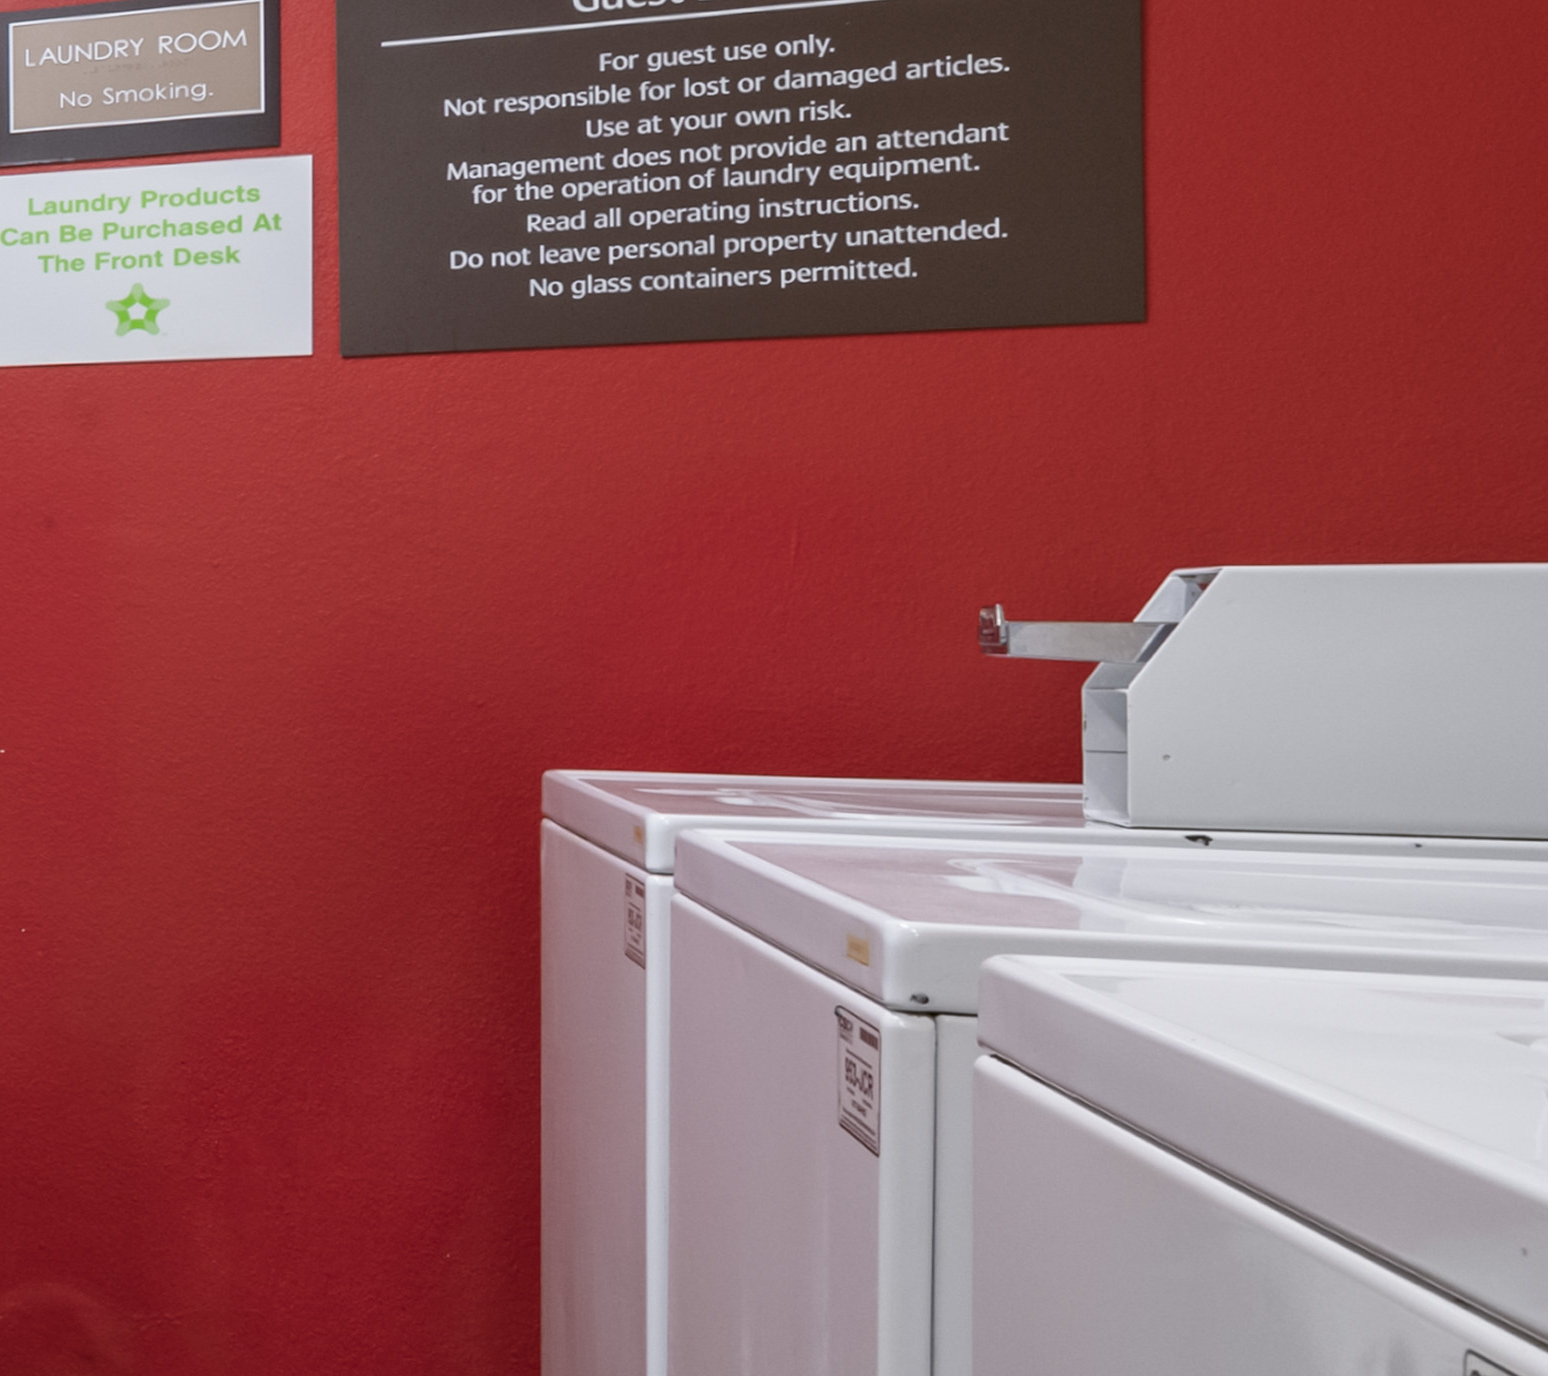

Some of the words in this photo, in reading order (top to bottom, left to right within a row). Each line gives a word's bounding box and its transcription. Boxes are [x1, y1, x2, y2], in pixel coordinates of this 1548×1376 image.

[26, 38, 143, 66] LAUNDRY
[159, 30, 246, 54] ROOM
[600, 53, 639, 71] For
[647, 45, 716, 72] guest
[724, 43, 766, 61] use
[775, 34, 834, 57] only.
[60, 91, 92, 108] No
[103, 82, 213, 104] Smoking.
[444, 98, 486, 116] Not
[494, 84, 631, 114] responsible
[640, 81, 676, 101] for
[684, 77, 730, 97] lost
[738, 76, 765, 92] or
[774, 61, 896, 90] damaged
[906, 54, 1010, 79] articles.
[586, 119, 629, 138] Use
[638, 116, 662, 134] at
[670, 113, 727, 136] your
[736, 108, 790, 126] own
[800, 99, 851, 122] risk.
[447, 153, 604, 180] Management
[612, 148, 671, 168] does
[680, 144, 722, 163] not
[731, 135, 826, 164] provide
[836, 136, 866, 152] an
[876, 123, 1009, 150] attendant
[472, 184, 507, 204] for
[515, 181, 554, 201] the
[562, 173, 680, 201] operation
[689, 168, 715, 189] of
[724, 163, 820, 186] laundry
[830, 153, 980, 183] equipment.
[28, 194, 130, 215] Laundry
[141, 186, 260, 208] Products
[528, 210, 585, 232] Read
[594, 208, 620, 228] all
[629, 201, 750, 230] operating
[759, 192, 918, 218] instructions.
[0, 228, 49, 246] Can
[60, 224, 92, 242] Be
[103, 216, 242, 240] Purchased
[254, 214, 280, 231] At
[450, 251, 483, 269] Do
[492, 248, 531, 266] not
[540, 245, 600, 264] leave
[609, 235, 714, 264] personal
[724, 230, 837, 258] property
[846, 217, 1007, 246] unattended.
[38, 255, 84, 272] The
[95, 251, 162, 270] Front
[174, 246, 239, 266] Desk
[530, 278, 563, 296] No
[571, 274, 632, 299] glass
[640, 268, 772, 291] containers
[781, 257, 917, 288] permitted.
